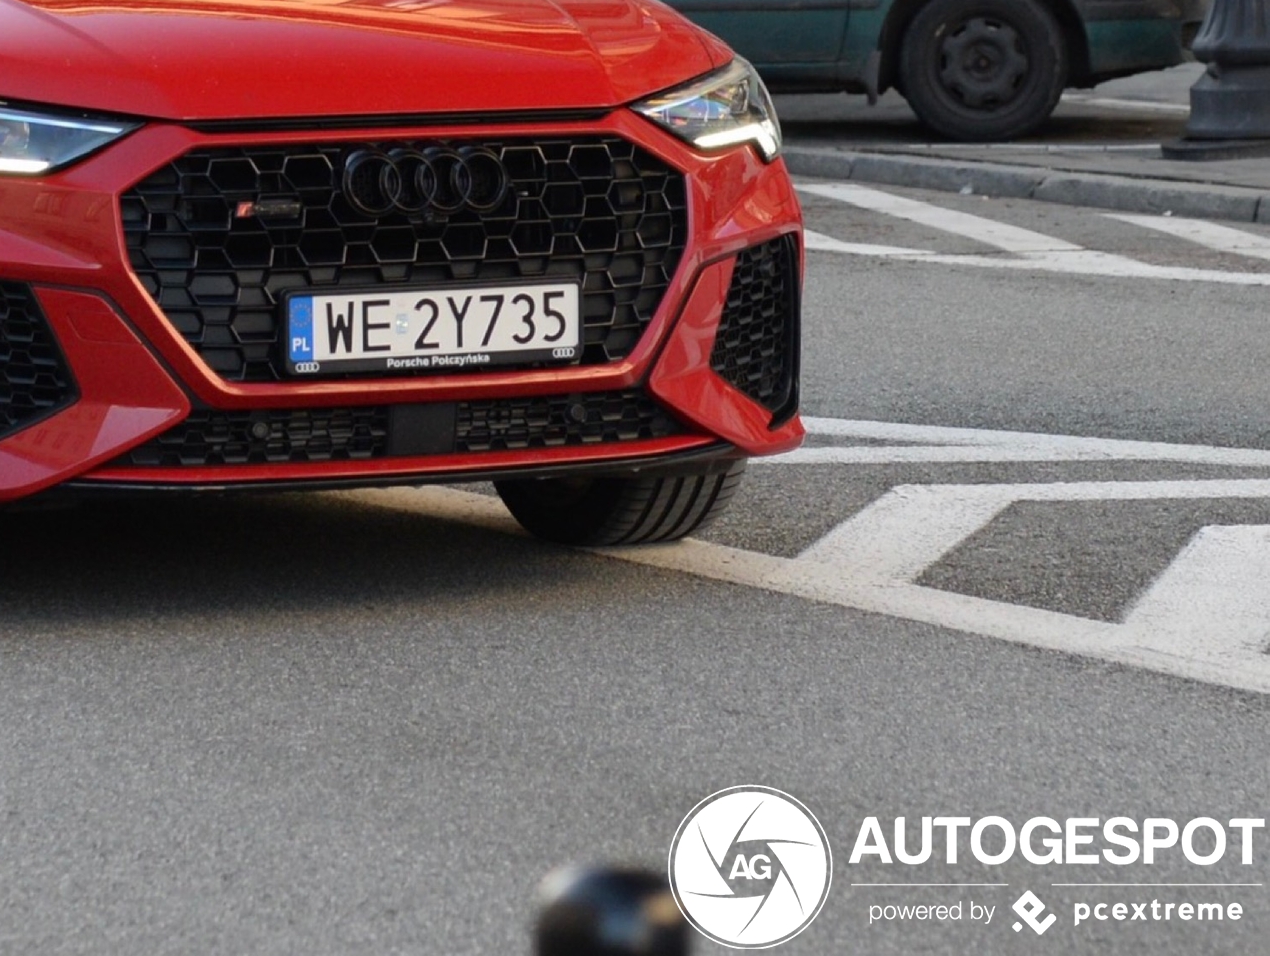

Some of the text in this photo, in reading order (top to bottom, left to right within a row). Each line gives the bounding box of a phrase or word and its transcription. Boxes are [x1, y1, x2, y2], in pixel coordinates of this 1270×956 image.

[325, 290, 568, 354] WE 2Y735
[292, 337, 310, 352] PL
[386, 353, 490, 369] Porsche Połczyńska
